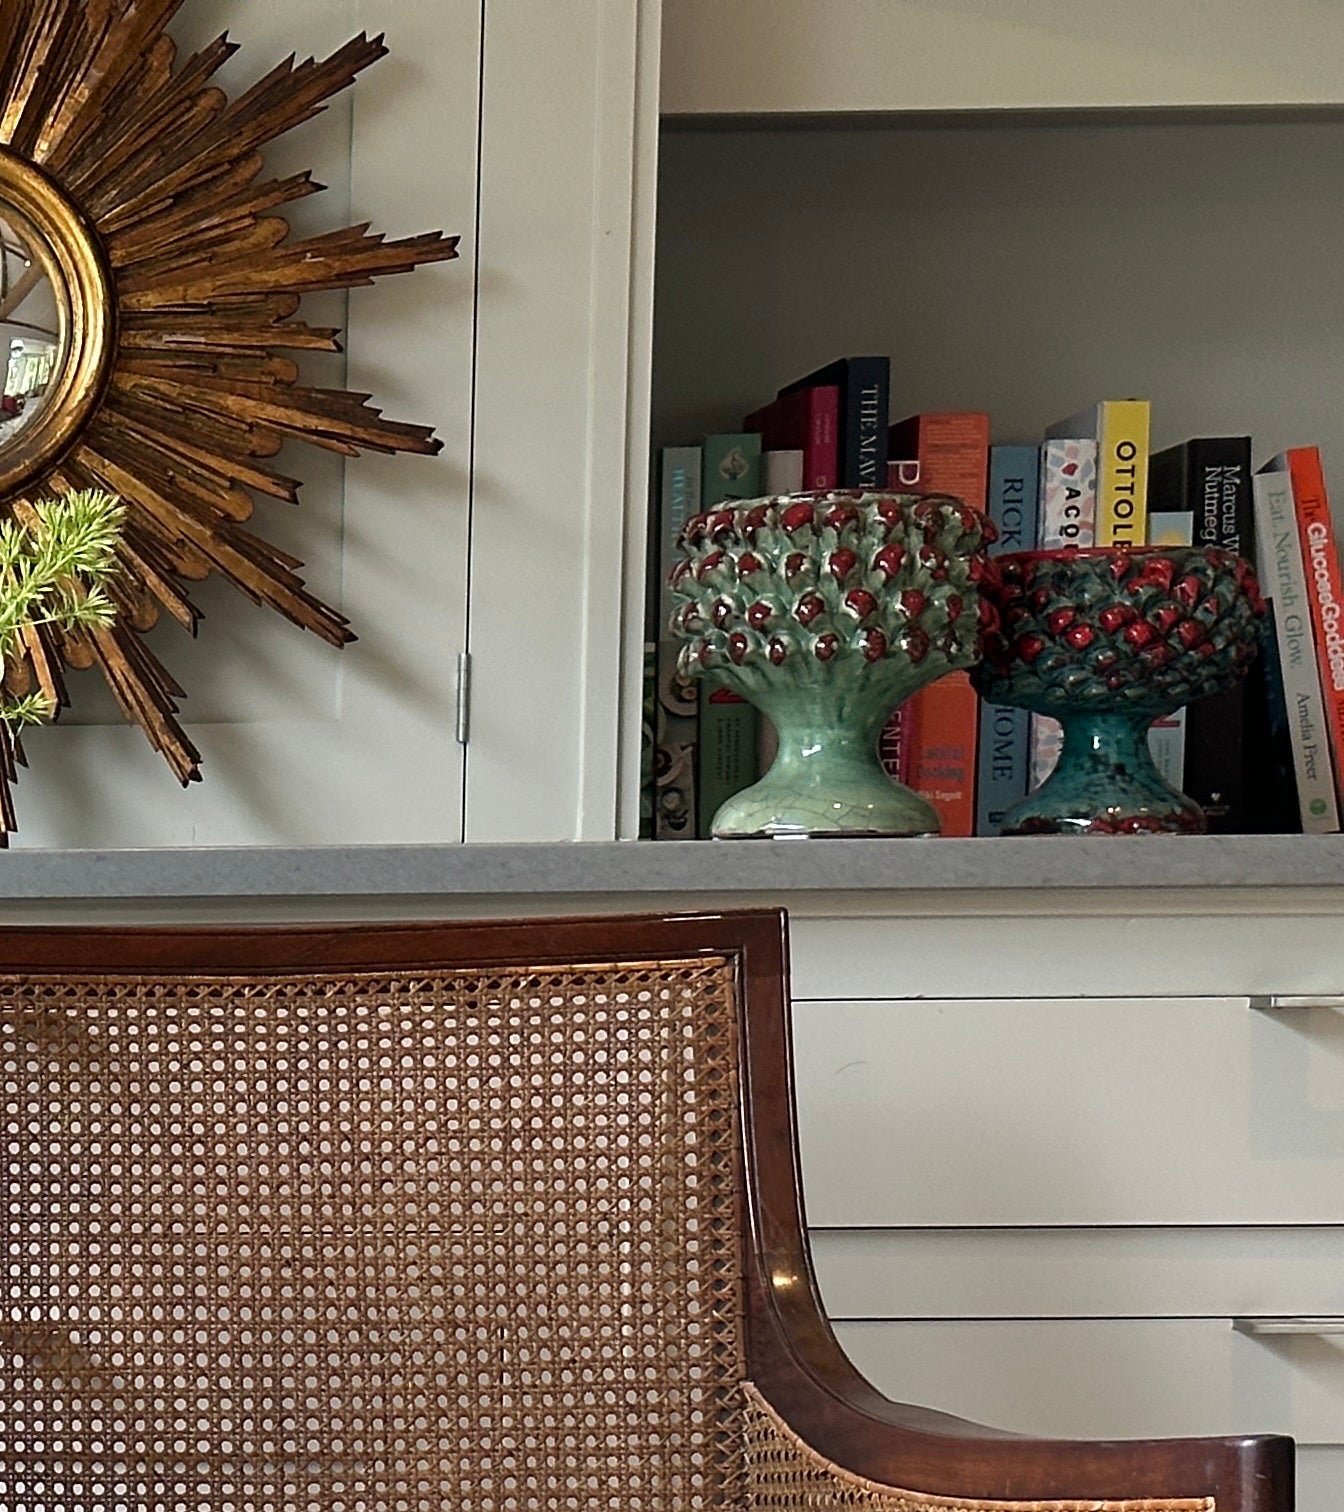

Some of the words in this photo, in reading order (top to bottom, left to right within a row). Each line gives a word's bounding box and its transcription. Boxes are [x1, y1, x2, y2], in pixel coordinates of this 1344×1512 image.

[859, 384, 879, 431] THE
[1001, 478, 1024, 549] RICK
[1199, 466, 1221, 541] Nutmeg
[1222, 465, 1242, 534] Marcus
[1284, 614, 1305, 669] Glow.
[1296, 693, 1314, 741] Amelia
[1301, 741, 1319, 781] Freer
